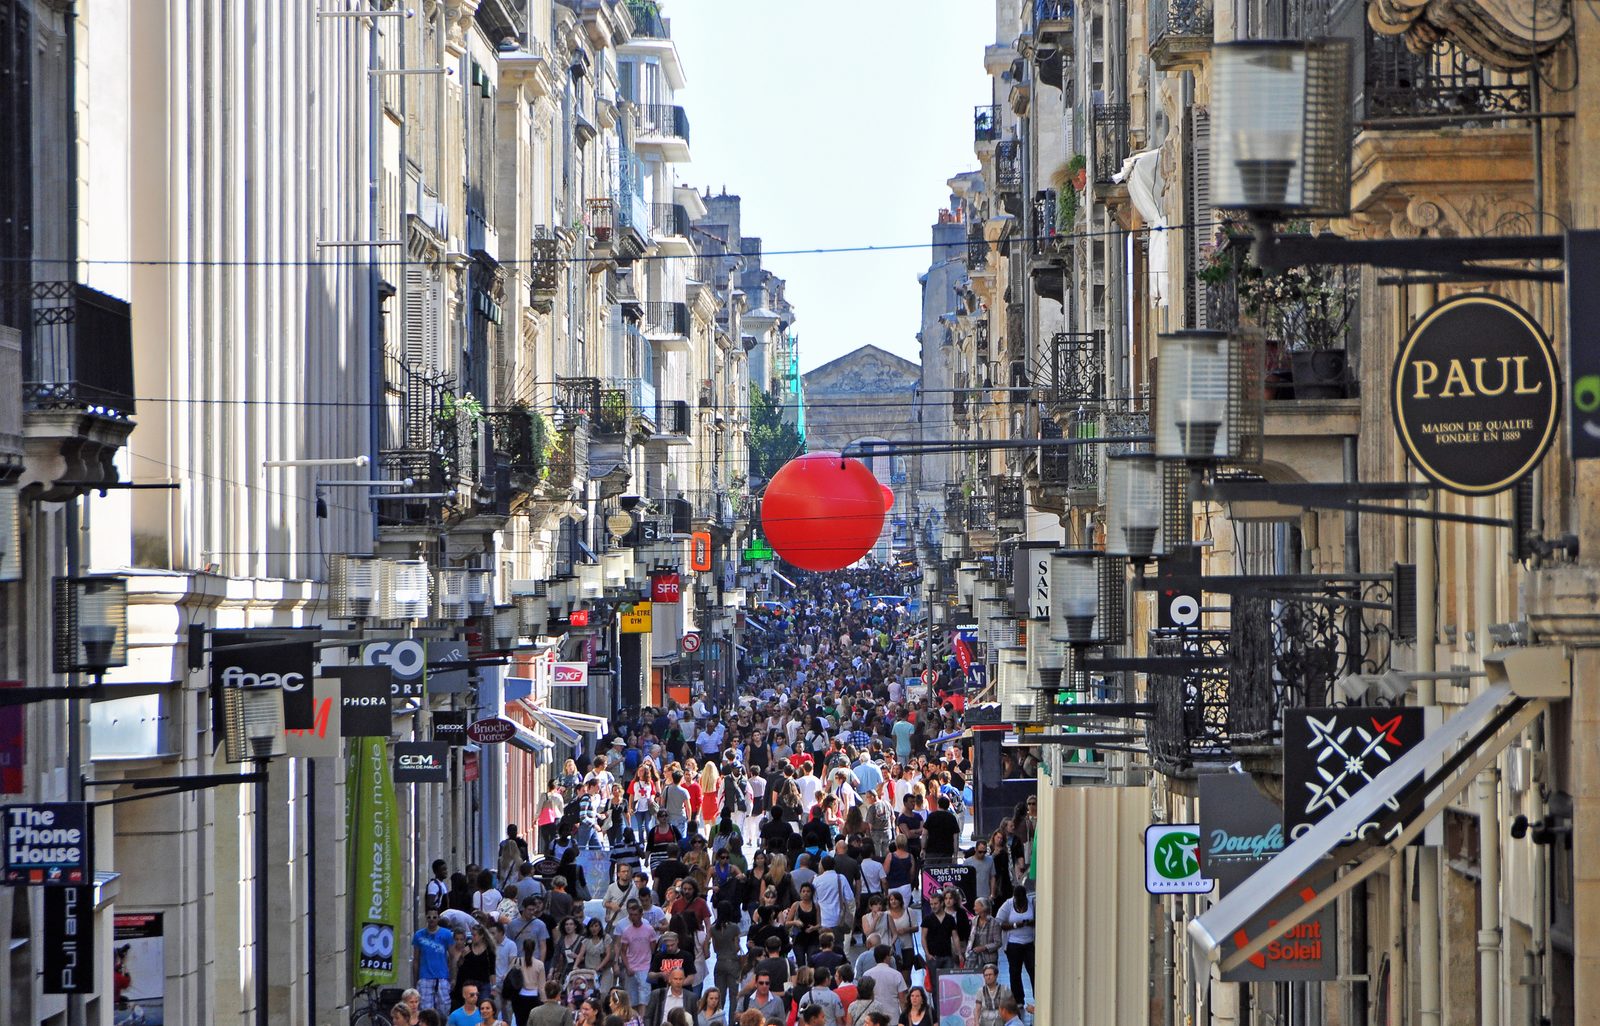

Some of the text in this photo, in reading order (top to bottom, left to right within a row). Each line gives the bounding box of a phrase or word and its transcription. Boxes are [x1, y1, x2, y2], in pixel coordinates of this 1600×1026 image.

[1412, 356, 1541, 398] PAUL
[1421, 419, 1533, 434] MAISON DE QUALITE
[1436, 431, 1521, 444] FONDEE EN 1889
[657, 584, 679, 593] SFR
[1037, 561, 1048, 600] SAN
[363, 640, 424, 676] GO
[959, 646, 968, 669] TABAC
[221, 666, 304, 691] fnac
[556, 671, 581, 680] SNCF
[391, 684, 423, 694] ORT
[343, 697, 387, 706] PHORA
[474, 721, 510, 734] Brioche
[399, 755, 433, 765] GDM
[10, 807, 55, 825] The
[10, 827, 80, 845] Phone
[368, 743, 383, 919] Rentrez en mode
[1209, 823, 1285, 857] Dougla
[10, 845, 80, 863] House
[951, 867, 969, 875] THIRD
[62, 887, 77, 989] Pull and
[361, 926, 394, 957] GO
[1267, 940, 1322, 960] Soleil
[361, 960, 392, 970] SPORT
